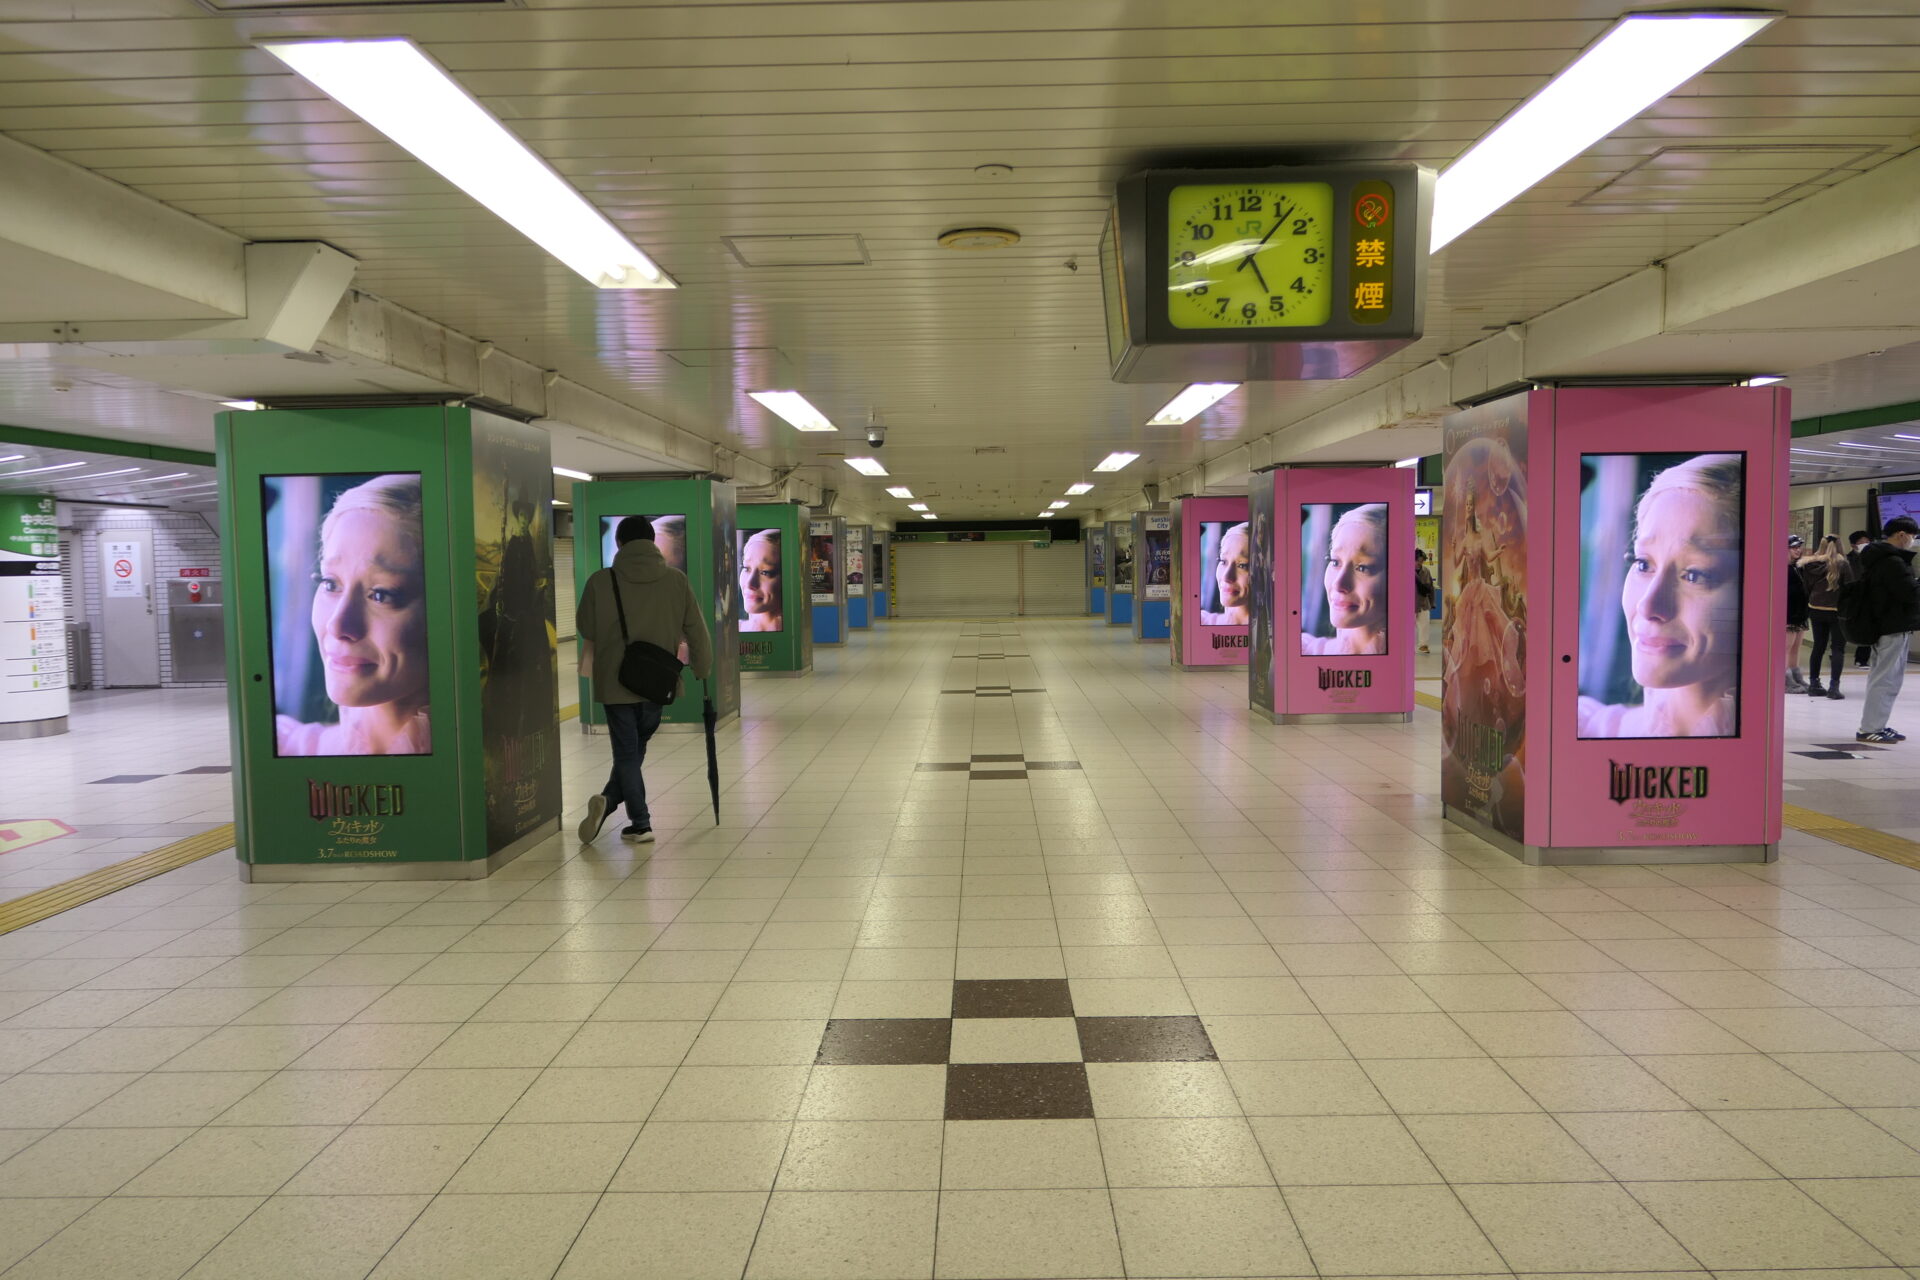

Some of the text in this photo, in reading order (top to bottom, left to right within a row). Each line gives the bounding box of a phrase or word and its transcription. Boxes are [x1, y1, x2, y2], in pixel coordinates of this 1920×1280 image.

[1238, 196, 1262, 212] 12
[1273, 202, 1282, 218] 1
[1213, 205, 1233, 221] 11
[1192, 224, 1214, 241] 10
[1236, 220, 1262, 235] JR
[1292, 219, 1307, 235] 2
[1181, 251, 1196, 267] 9
[1304, 248, 1318, 264] 3
[1355, 239, 1385, 309] 禁煙
[1290, 277, 1306, 293] 4
[1216, 298, 1231, 314] 7
[1242, 303, 1257, 319] 6
[1269, 296, 1284, 312] 5
[1211, 632, 1249, 650] WICKED
[1318, 666, 1372, 691] WICKED
[1608, 758, 1708, 806] WICKED
[306, 778, 403, 823] WICKED
[328, 817, 384, 836] ウィキッド
